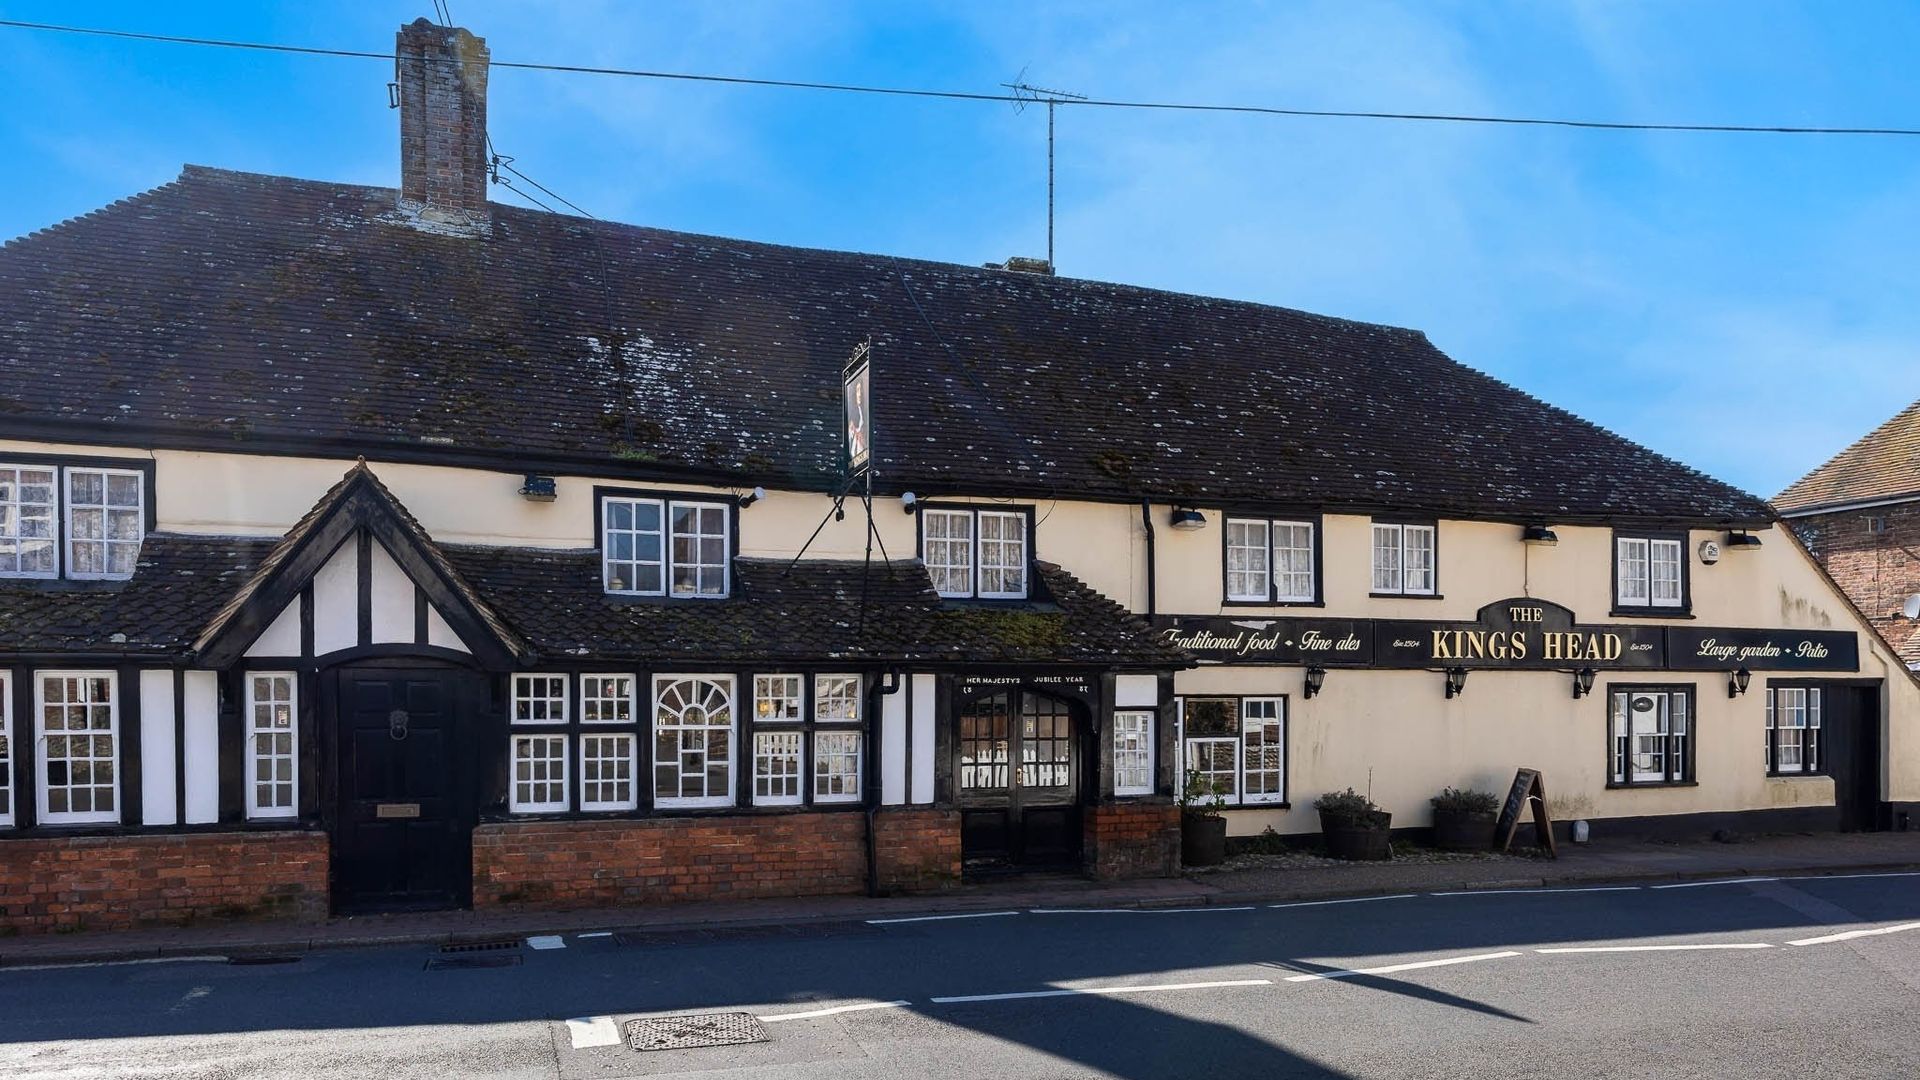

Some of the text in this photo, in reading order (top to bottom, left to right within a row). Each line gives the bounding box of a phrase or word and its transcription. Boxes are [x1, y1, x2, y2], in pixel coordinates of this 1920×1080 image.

[1510, 607, 1543, 622] THE
[1237, 632, 1280, 656] food
[1299, 630, 1332, 651] Fine
[1335, 633, 1361, 651] ales
[1431, 630, 1622, 660] KINGS HEAD
[1697, 638, 1829, 661] Large garden Patio
